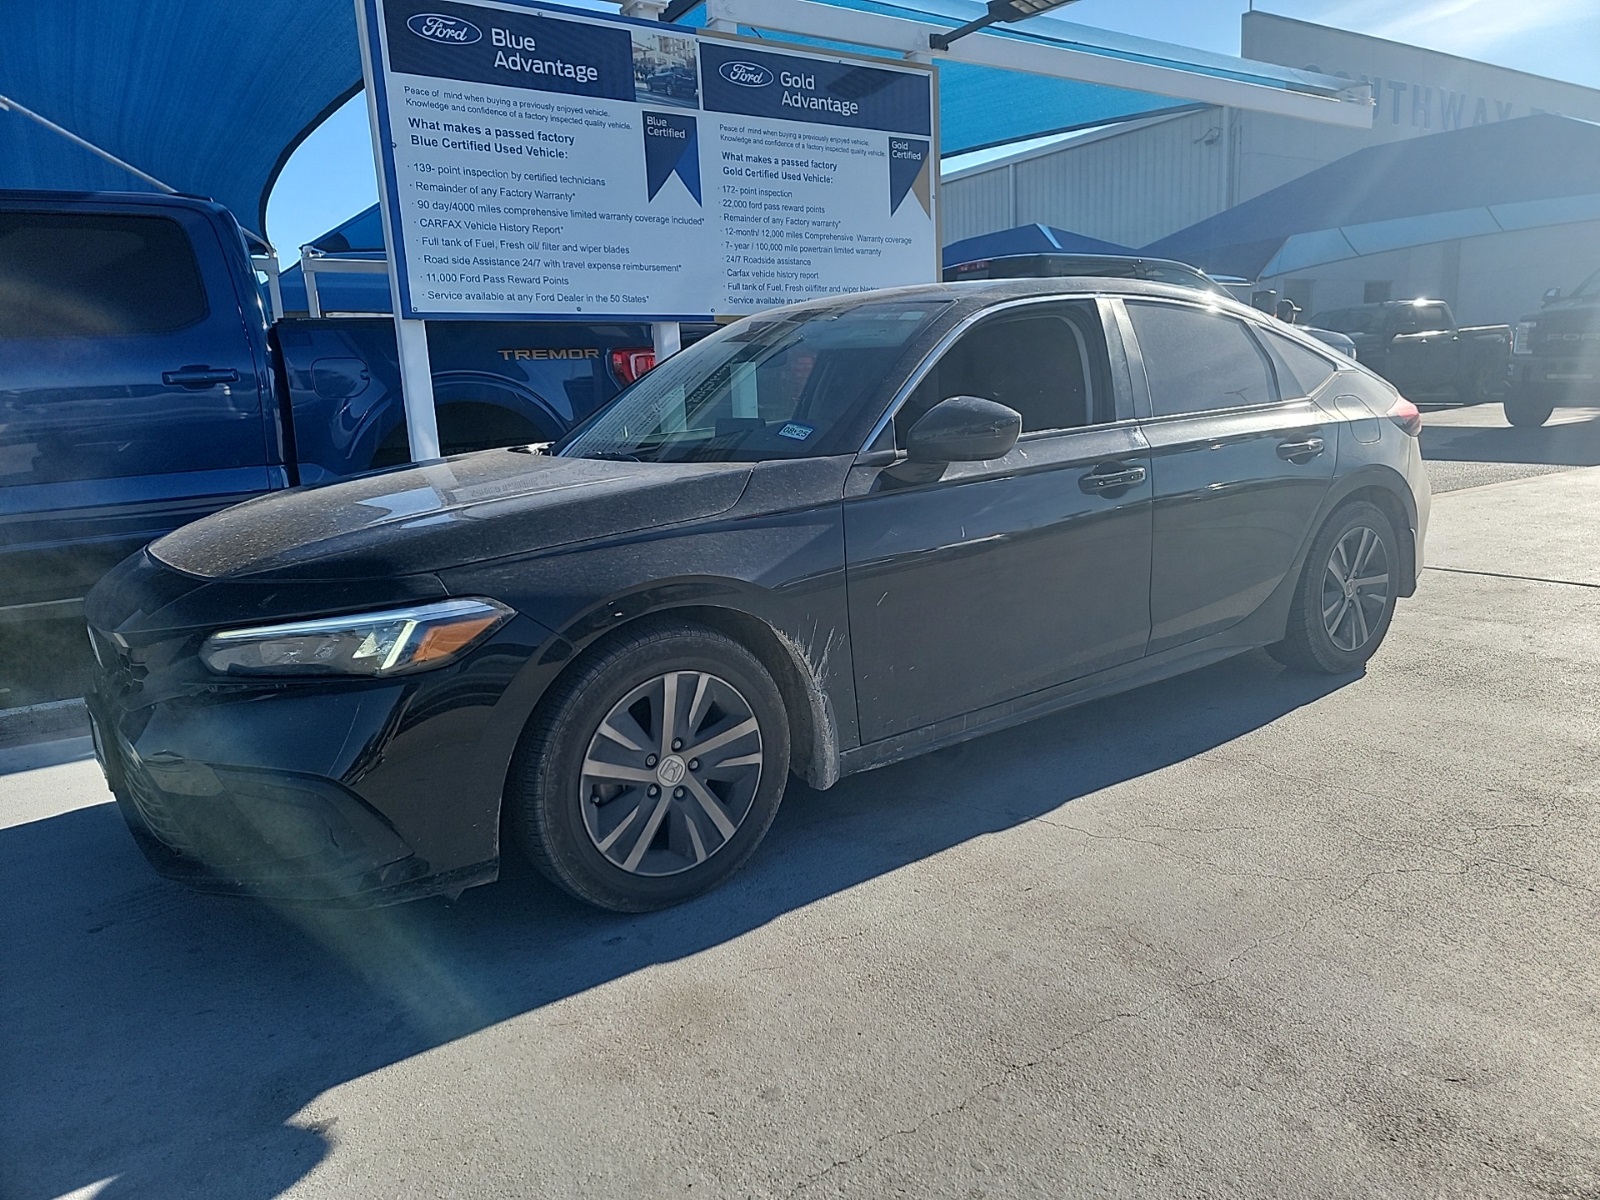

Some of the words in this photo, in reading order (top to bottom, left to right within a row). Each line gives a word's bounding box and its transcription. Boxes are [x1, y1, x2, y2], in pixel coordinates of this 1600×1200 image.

[422, 16, 468, 42] Ford
[491, 28, 536, 50] Blue
[494, 50, 598, 82] Advantage
[730, 64, 763, 84] Ford
[780, 72, 814, 90] Gold
[404, 86, 430, 96] Peace
[444, 91, 462, 100] mind
[464, 94, 484, 103] when
[487, 96, 510, 107] buying
[520, 100, 555, 112] previously
[557, 105, 584, 115] enjoyed
[585, 108, 610, 117] vehicle.
[782, 90, 858, 116] Advantage
[406, 98, 449, 111] Knowledge
[452, 104, 466, 112] and
[468, 106, 508, 117] confidence
[525, 112, 548, 122] factory
[550, 114, 584, 126] inspected
[584, 118, 606, 128] quality
[608, 121, 632, 130] vehicle.
[646, 116, 668, 127] Blue
[408, 117, 440, 131] What
[444, 122, 482, 134] makes
[484, 128, 492, 136] a
[495, 128, 534, 140] passed
[538, 131, 574, 146] factory
[647, 126, 686, 138] Certified
[411, 135, 438, 147] Blue
[442, 138, 491, 152] Certified
[494, 142, 522, 155] Used
[525, 146, 568, 158] Vehicle:
[892, 141, 908, 150] Gold
[722, 151, 744, 162] What
[746, 154, 772, 164] makes
[781, 158, 808, 168] passed
[811, 160, 838, 171] factory
[892, 150, 921, 160] Certified
[438, 166, 460, 176] point
[463, 166, 508, 179] inspection
[511, 171, 522, 181] by
[524, 172, 558, 182] certified
[560, 174, 606, 186] technicians
[722, 166, 742, 176] Gold
[745, 168, 779, 179] Certified
[781, 172, 801, 181] Used
[803, 173, 833, 184] Vehicle:
[416, 182, 466, 194] Remainder
[470, 186, 478, 194] of
[481, 188, 497, 197] any
[500, 188, 532, 200] Factory
[740, 187, 756, 196] point
[758, 188, 792, 198] inspection
[417, 200, 430, 210] 90
[432, 201, 475, 212] day/4000
[478, 204, 501, 214] miles
[504, 206, 568, 218] comprehensive
[570, 210, 596, 219] limited
[598, 213, 632, 223] warranty
[635, 215, 670, 225] coverage
[722, 199, 747, 208] 22,000
[748, 200, 762, 209] ford
[782, 204, 804, 212] reward
[806, 206, 825, 214] points
[420, 218, 462, 229] CARFAX
[464, 220, 496, 231] Vehicle
[500, 222, 530, 234] History
[724, 213, 762, 223] Remainder
[772, 218, 784, 226] any
[786, 217, 810, 227] Factory
[422, 236, 438, 246] Full
[442, 238, 461, 247] tank
[464, 239, 472, 248] of
[476, 239, 498, 249] Fuel,
[500, 240, 525, 250] Fresh
[542, 242, 560, 251] filter
[562, 243, 578, 252] and
[580, 244, 602, 254] wiper
[604, 245, 630, 254] blades
[762, 230, 784, 238] 12,000
[804, 232, 854, 242] Comprehensive
[884, 236, 912, 245] coverage
[756, 243, 783, 252] 100,000
[784, 244, 798, 252] mile
[800, 246, 832, 254] powertrain
[424, 255, 448, 264] Road
[452, 256, 470, 265] side
[472, 257, 520, 266] Assistance
[522, 259, 540, 267] 24/7
[544, 259, 560, 268] with
[562, 260, 586, 269] travel
[588, 263, 620, 272] expense
[726, 255, 741, 264] 24/7
[744, 256, 775, 264] Roadside
[776, 257, 811, 266] assistance
[426, 274, 457, 283] 11,000
[460, 274, 480, 283] Ford
[483, 274, 505, 284] Pass
[508, 275, 540, 284] Reward
[543, 276, 569, 285] Points
[727, 268, 750, 277] Carfax
[752, 270, 774, 278] vehicle
[776, 270, 798, 280] history
[428, 291, 462, 300] Service
[465, 292, 504, 300] available
[518, 294, 532, 303] any
[536, 293, 554, 302] Ford
[558, 293, 584, 302] Dealer
[586, 294, 594, 302] in
[596, 294, 608, 302] the
[610, 294, 620, 302] 50
[728, 296, 753, 304] Service
[498, 349, 600, 360] TREMOR
